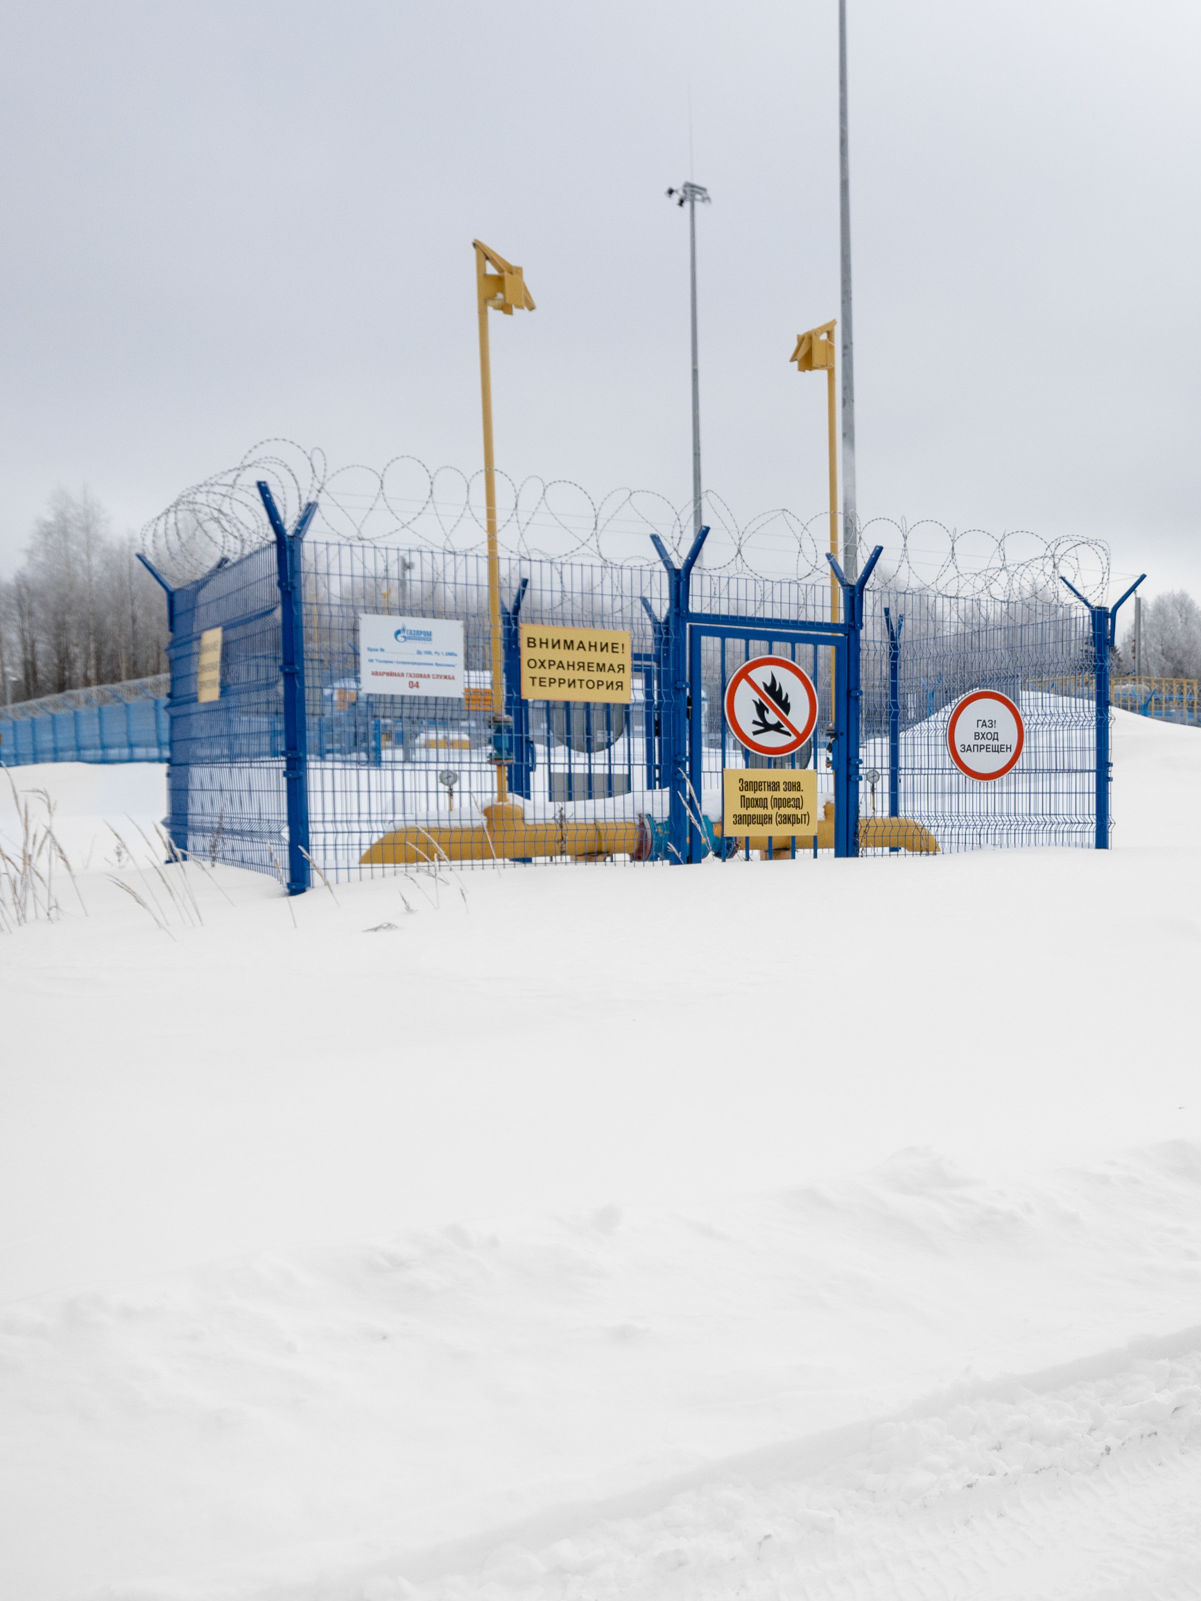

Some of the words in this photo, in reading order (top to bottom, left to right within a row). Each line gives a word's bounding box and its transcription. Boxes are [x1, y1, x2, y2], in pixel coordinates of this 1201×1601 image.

[526, 636, 625, 654] ВНИМАНИЕ!
[527, 658, 625, 674] ОХРАНЯЕМАЯ
[408, 681, 420, 689] 04
[528, 676, 624, 691] ТЕРРИТОРИЯ
[976, 719, 996, 728] ГАЗ!
[974, 731, 999, 742] ВХОД
[960, 744, 1012, 754] ЗАПРЕЩЕН
[739, 778, 780, 794] Запретная
[783, 780, 804, 792] зона.
[740, 795, 768, 811] Проход
[770, 795, 804, 811] (проезд)
[732, 812, 773, 827] запрещен
[775, 811, 810, 827] (закрыт)
